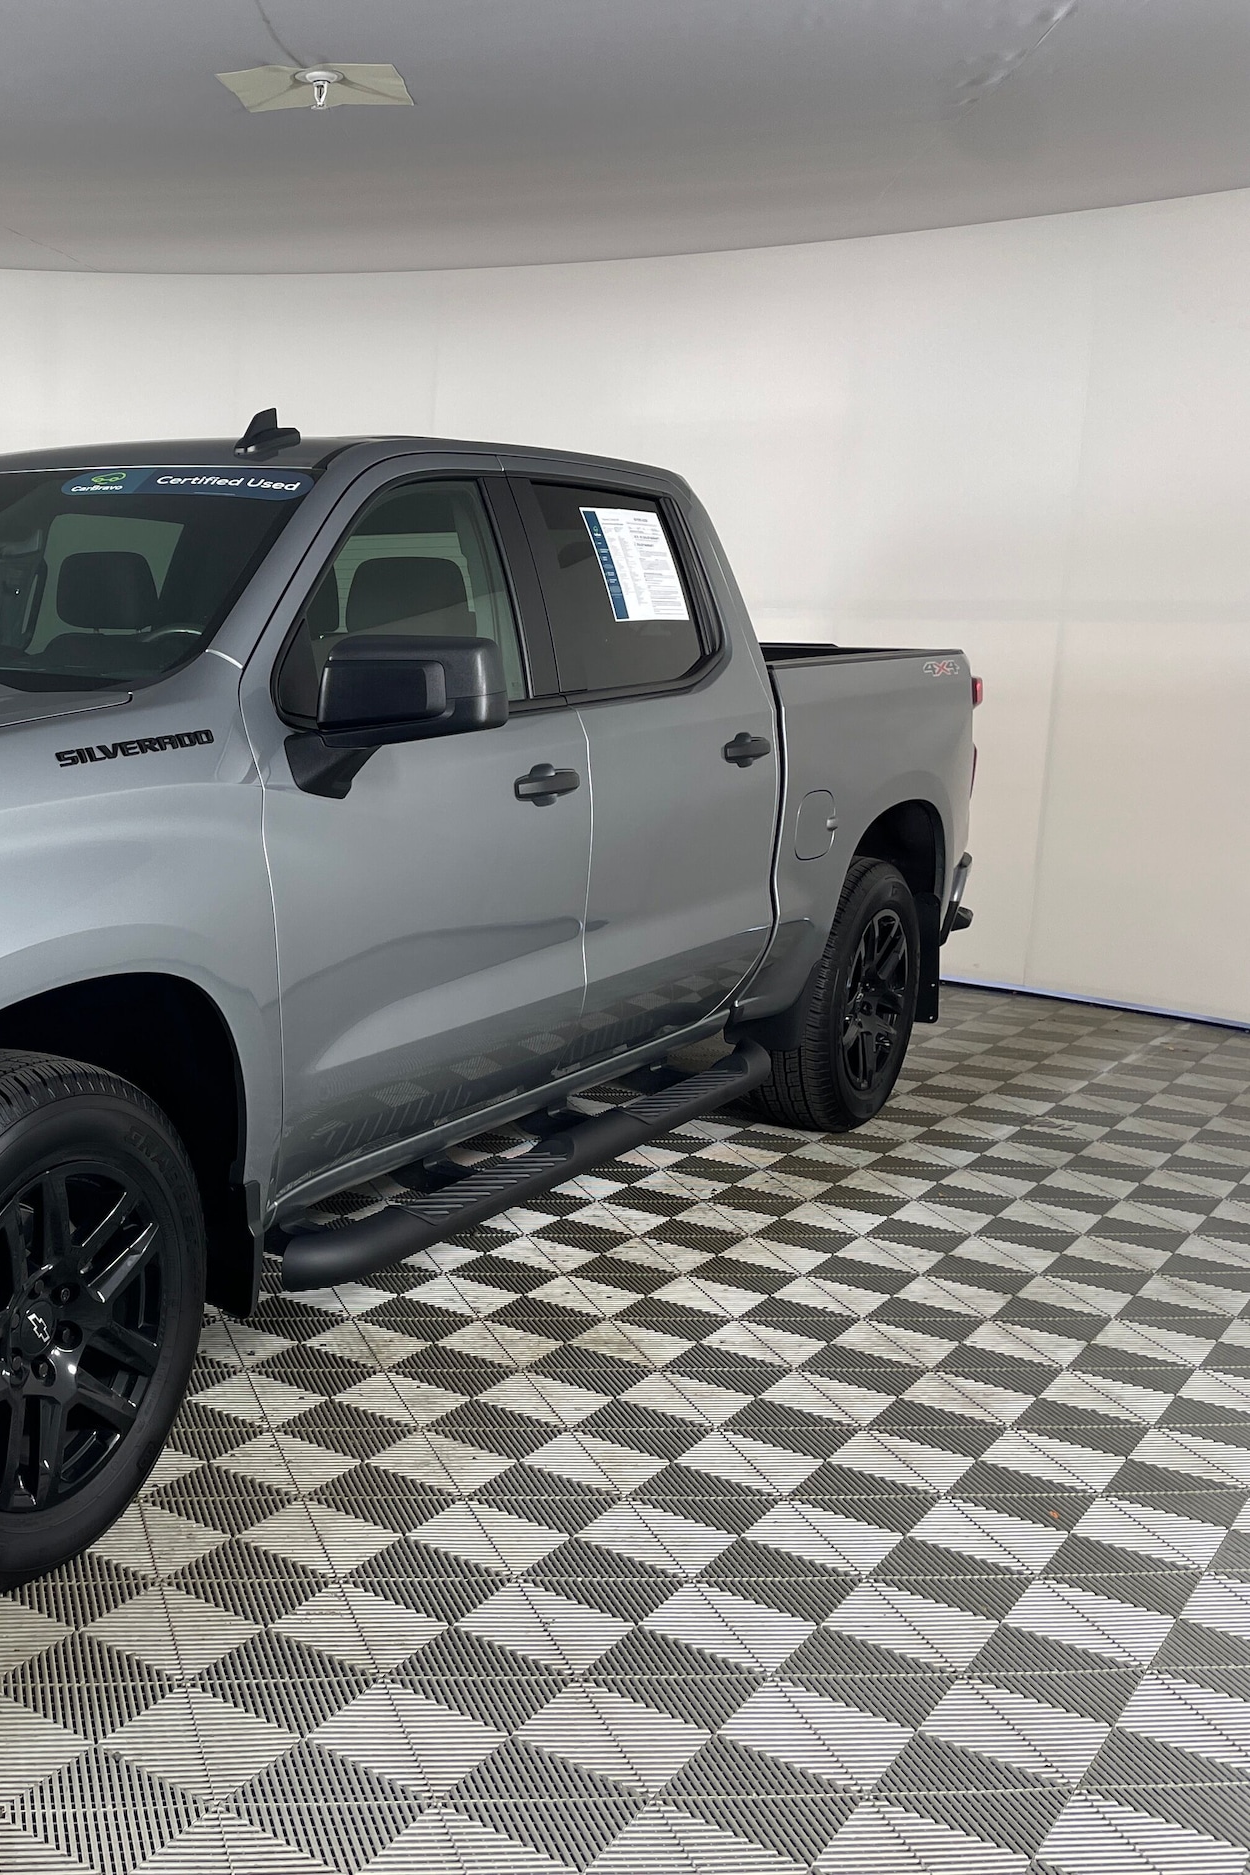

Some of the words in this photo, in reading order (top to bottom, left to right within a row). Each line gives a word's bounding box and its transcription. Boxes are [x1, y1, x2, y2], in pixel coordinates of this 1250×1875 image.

[70, 484, 123, 492] CarBravo
[155, 475, 241, 488] Certified
[247, 478, 301, 492] Used
[54, 729, 214, 768] SILVERADO
